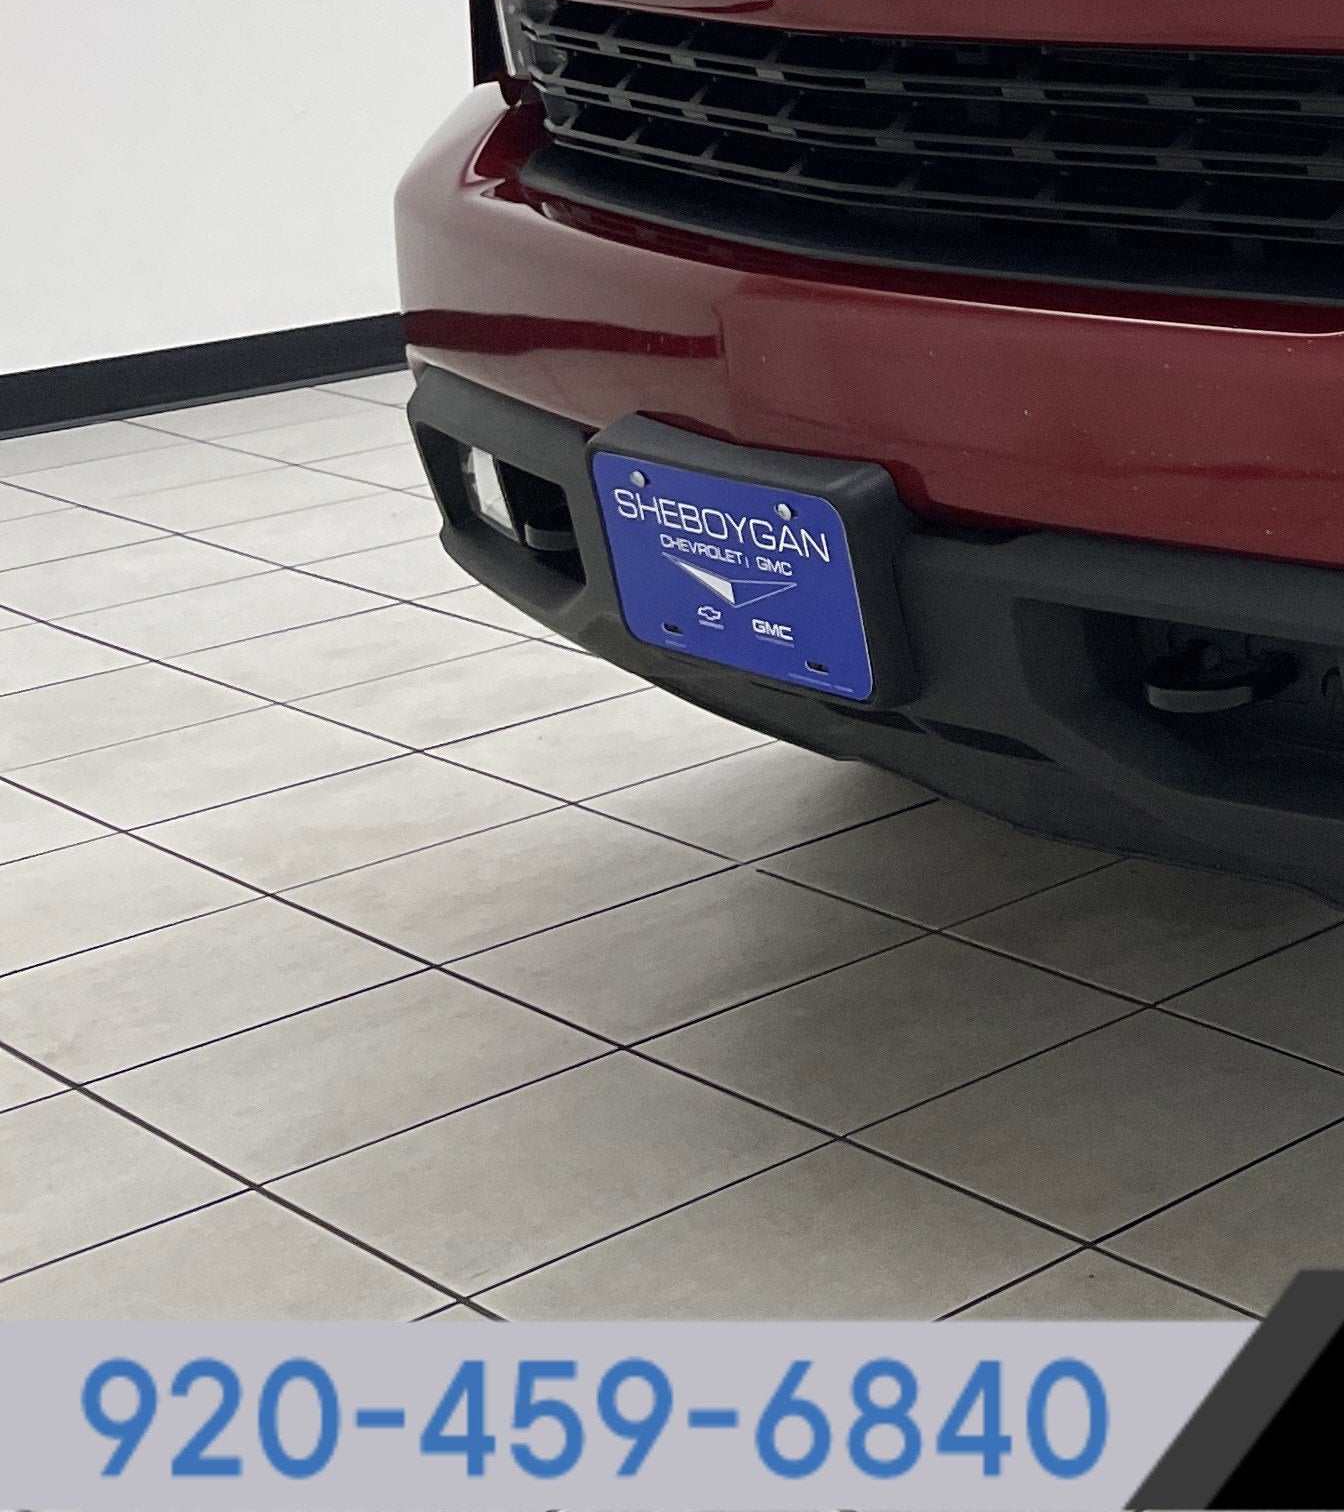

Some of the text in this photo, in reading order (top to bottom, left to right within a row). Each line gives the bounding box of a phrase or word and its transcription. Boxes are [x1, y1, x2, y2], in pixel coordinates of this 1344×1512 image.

[613, 488, 830, 563] SHEBOYGAN
[659, 533, 793, 577] CHEVROLET GMC
[752, 618, 794, 641] GMC
